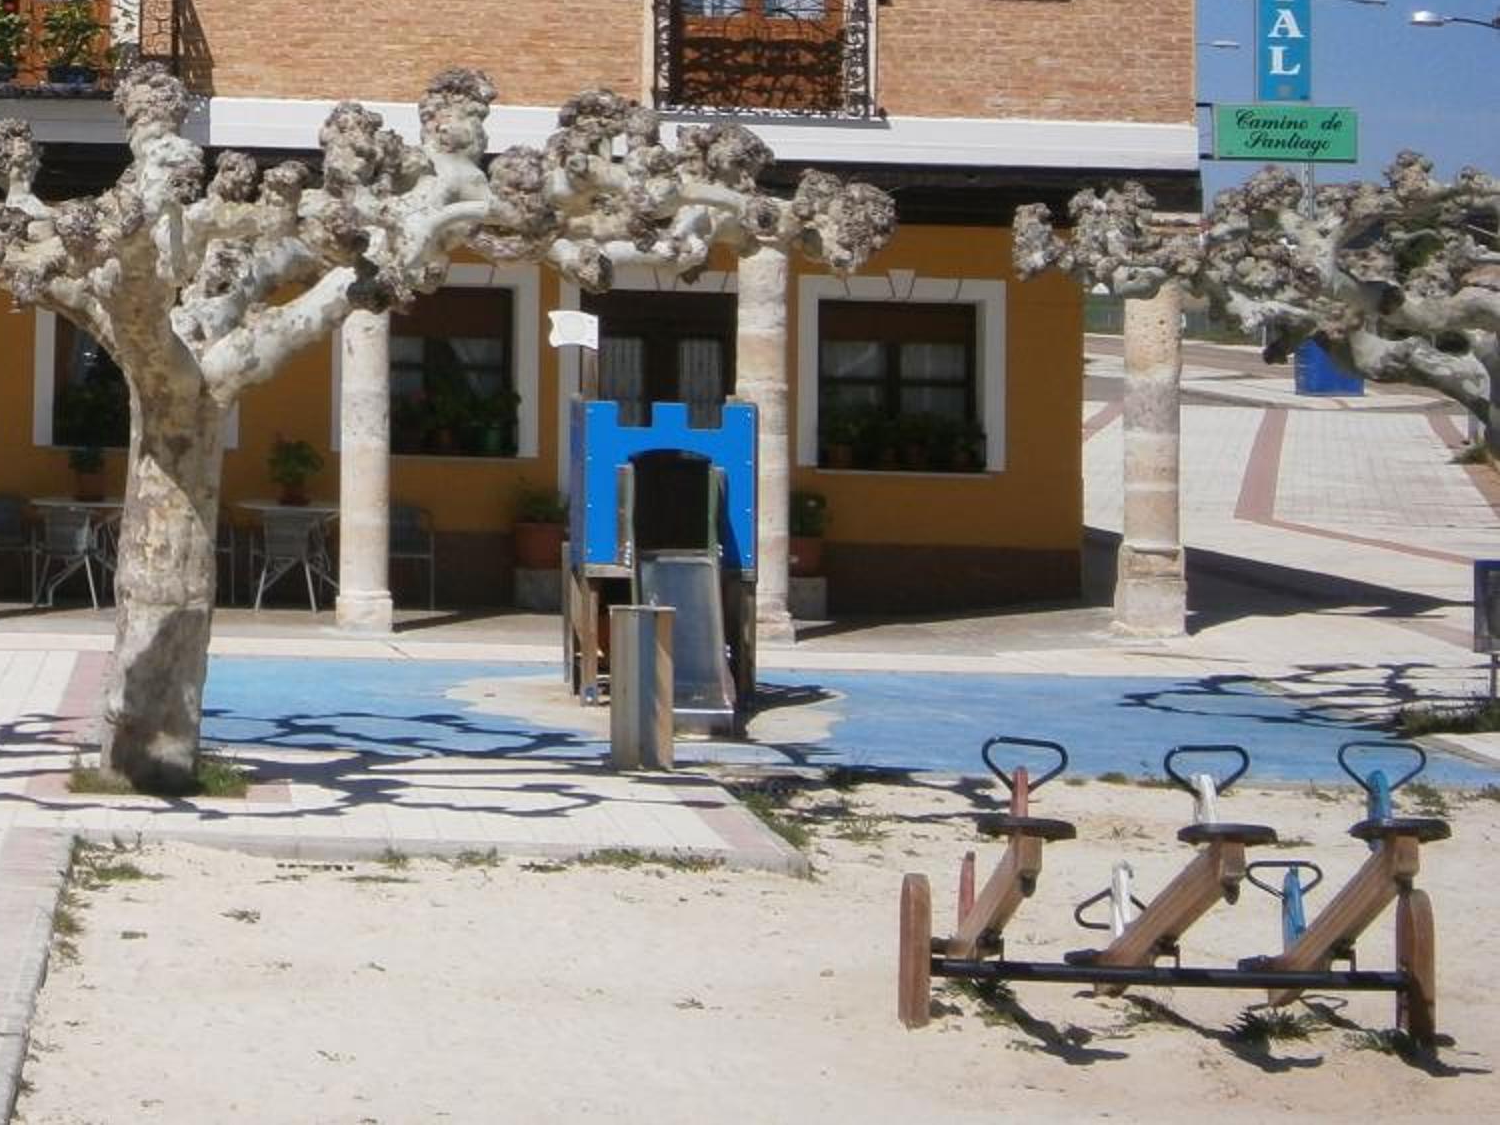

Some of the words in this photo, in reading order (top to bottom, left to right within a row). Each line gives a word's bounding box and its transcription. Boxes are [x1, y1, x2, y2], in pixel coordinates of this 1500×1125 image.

[1235, 108, 1309, 131] Camino
[1321, 111, 1343, 131] de
[1244, 131, 1330, 156] Santiago
